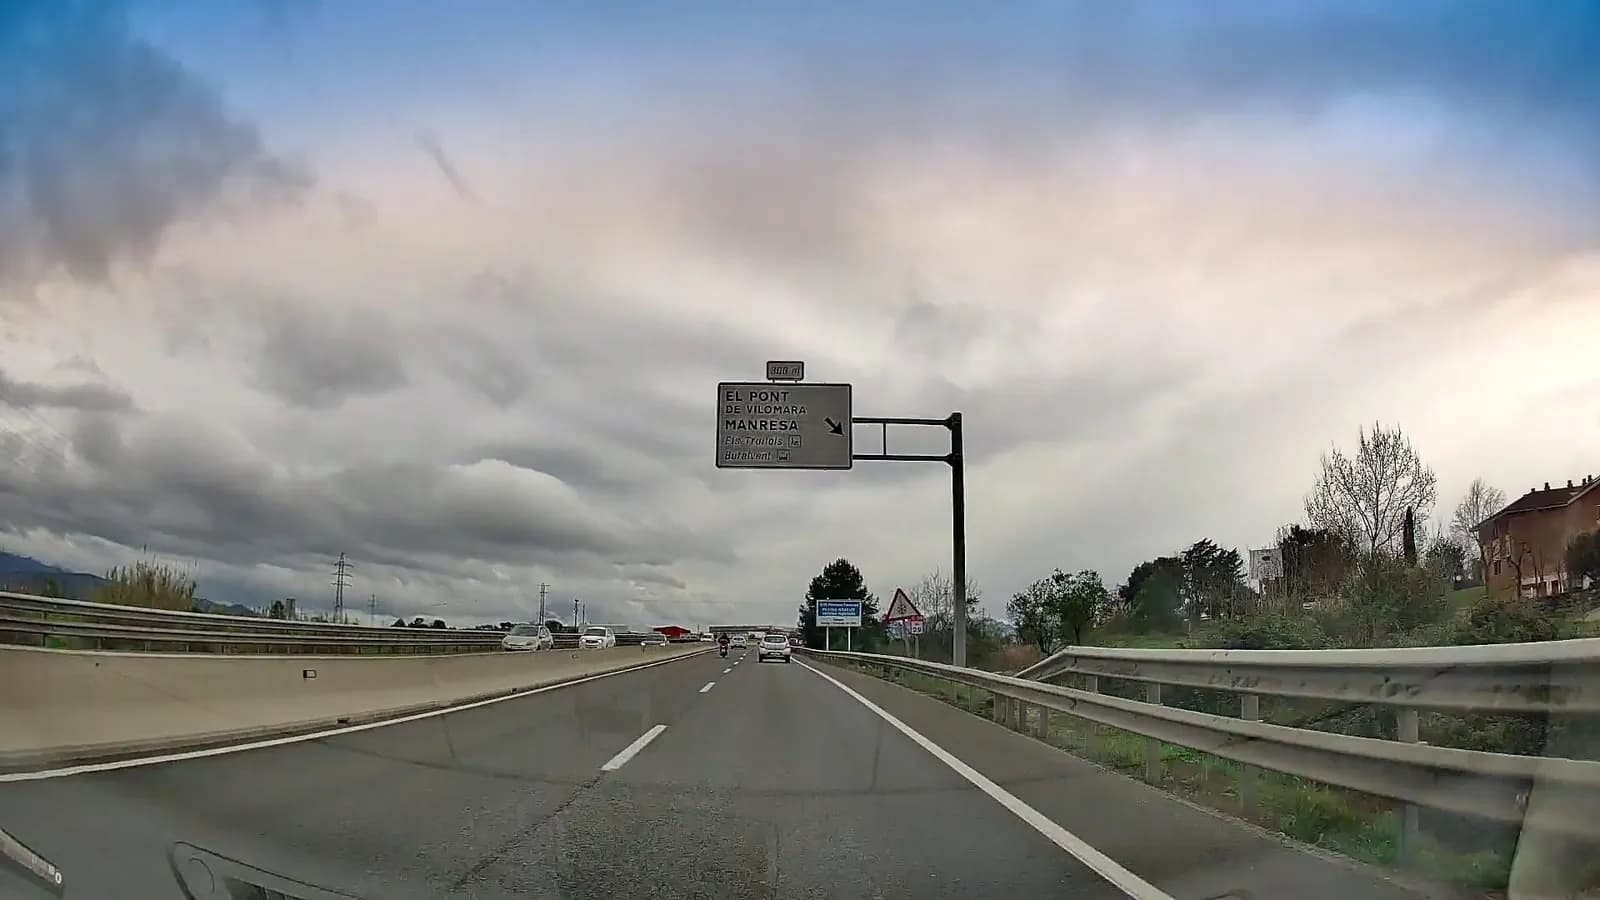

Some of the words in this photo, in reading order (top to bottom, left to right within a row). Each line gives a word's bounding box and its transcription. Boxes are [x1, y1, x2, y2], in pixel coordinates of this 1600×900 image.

[726, 391, 742, 401] EL
[749, 391, 789, 401] PONT
[725, 405, 741, 414] DE
[746, 405, 806, 414] VILOMARA
[725, 420, 798, 430] MANRESA
[725, 436, 742, 445] Els
